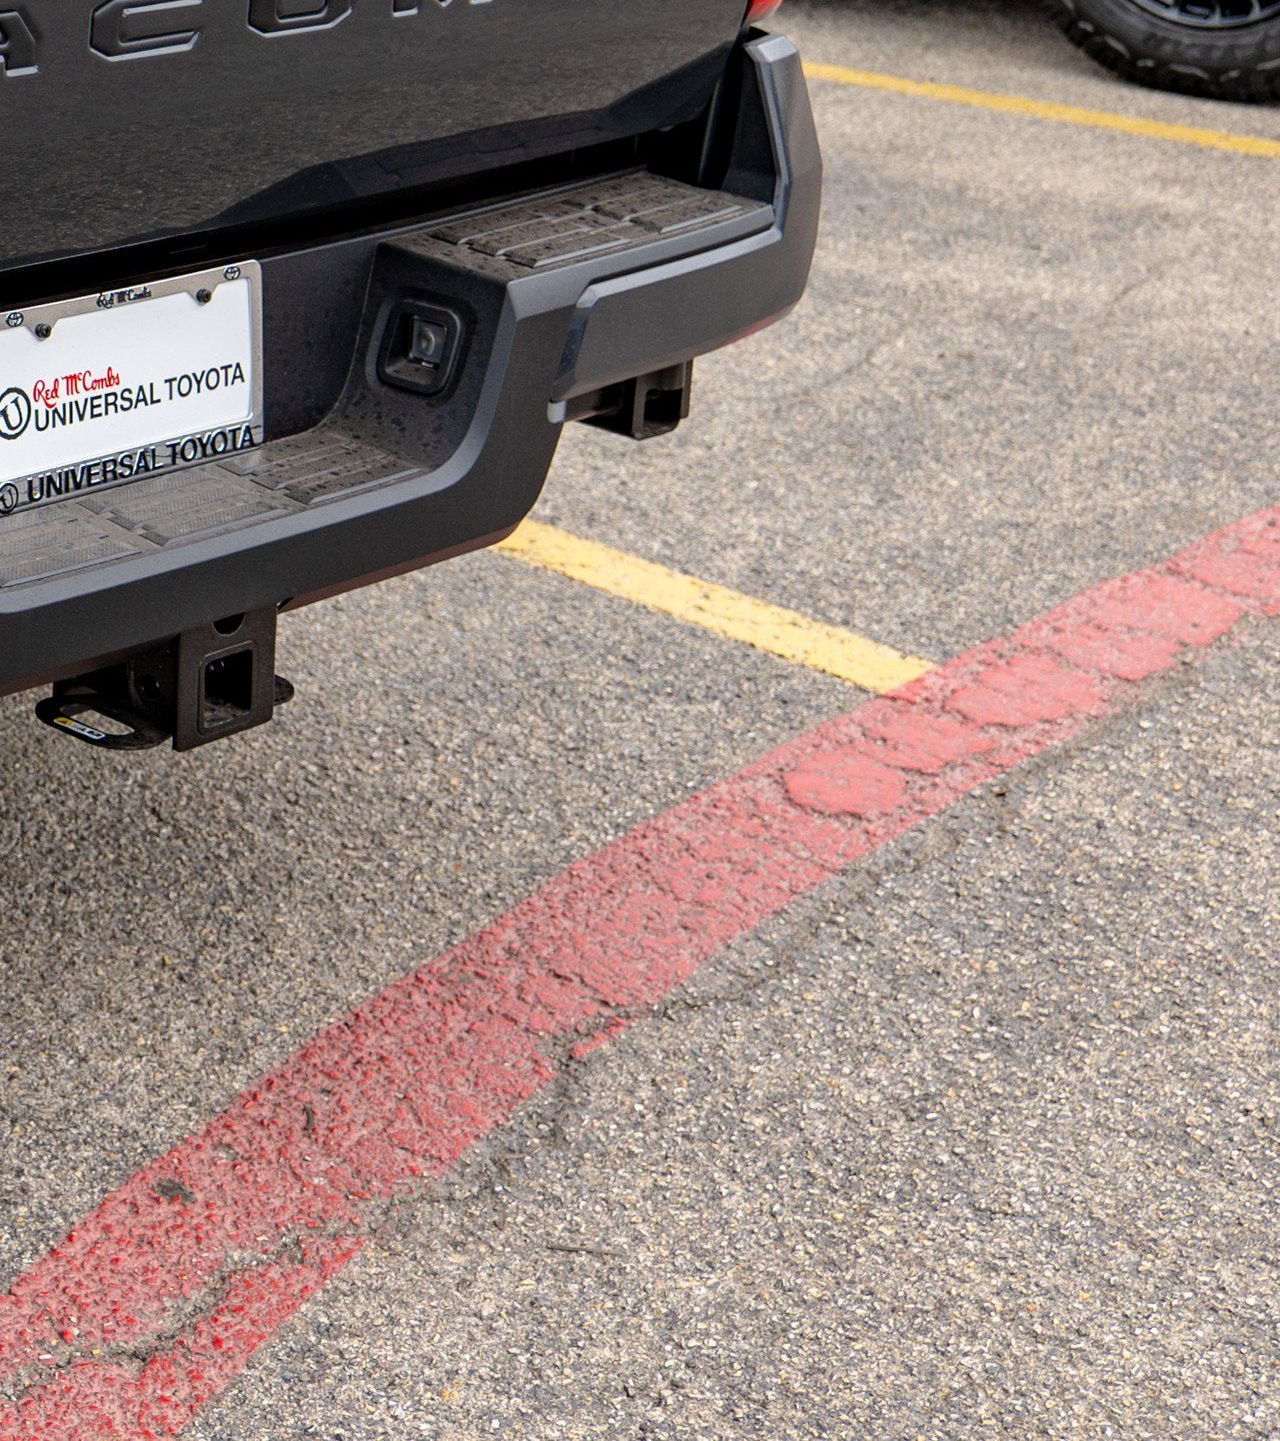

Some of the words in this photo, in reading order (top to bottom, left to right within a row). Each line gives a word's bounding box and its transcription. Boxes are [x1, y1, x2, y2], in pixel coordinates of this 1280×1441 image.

[33, 379, 59, 409] Red
[61, 366, 120, 396] McCombs
[35, 383, 161, 431] UNIVERSAL
[164, 362, 245, 400] TOYOTA
[27, 446, 164, 502] UNIVERSAL
[166, 423, 255, 465] TOYOTA
